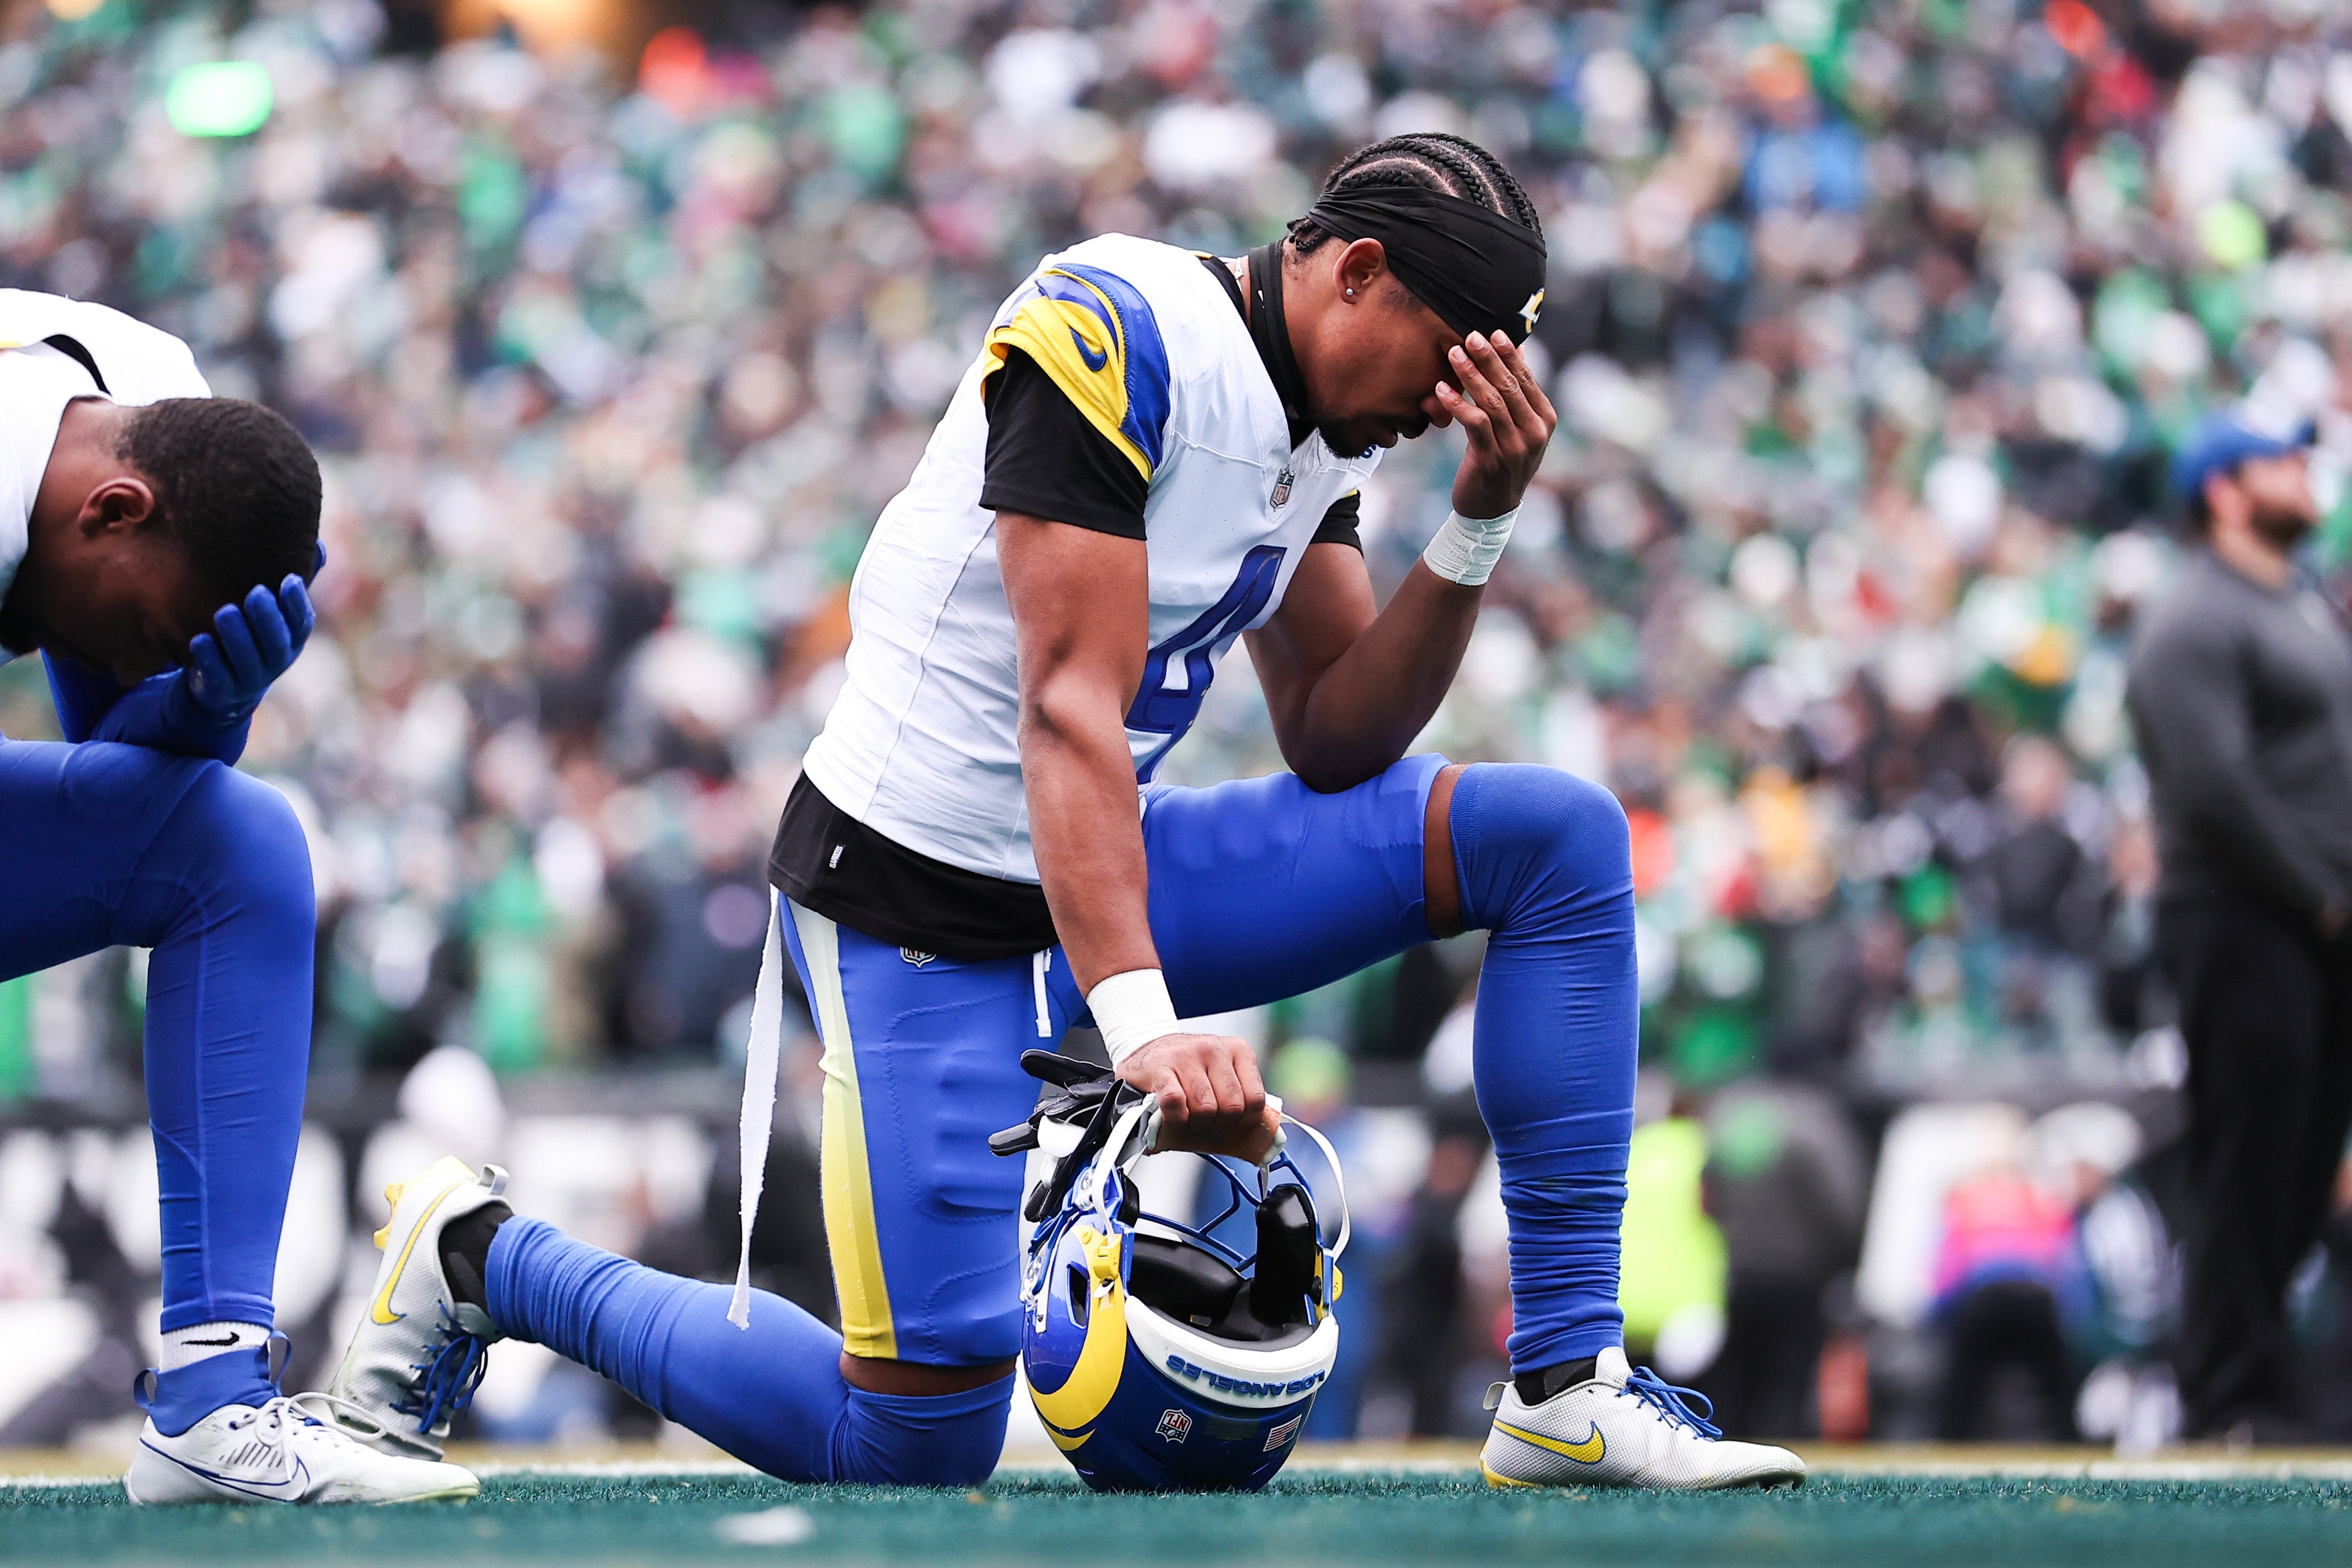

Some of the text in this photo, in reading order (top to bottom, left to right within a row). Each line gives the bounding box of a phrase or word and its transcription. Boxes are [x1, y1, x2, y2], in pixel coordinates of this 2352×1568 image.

[1125, 544, 1288, 785] 4
[1166, 1354, 1325, 1396] LOS ANGELES
[1167, 1413, 1188, 1431] NFL
